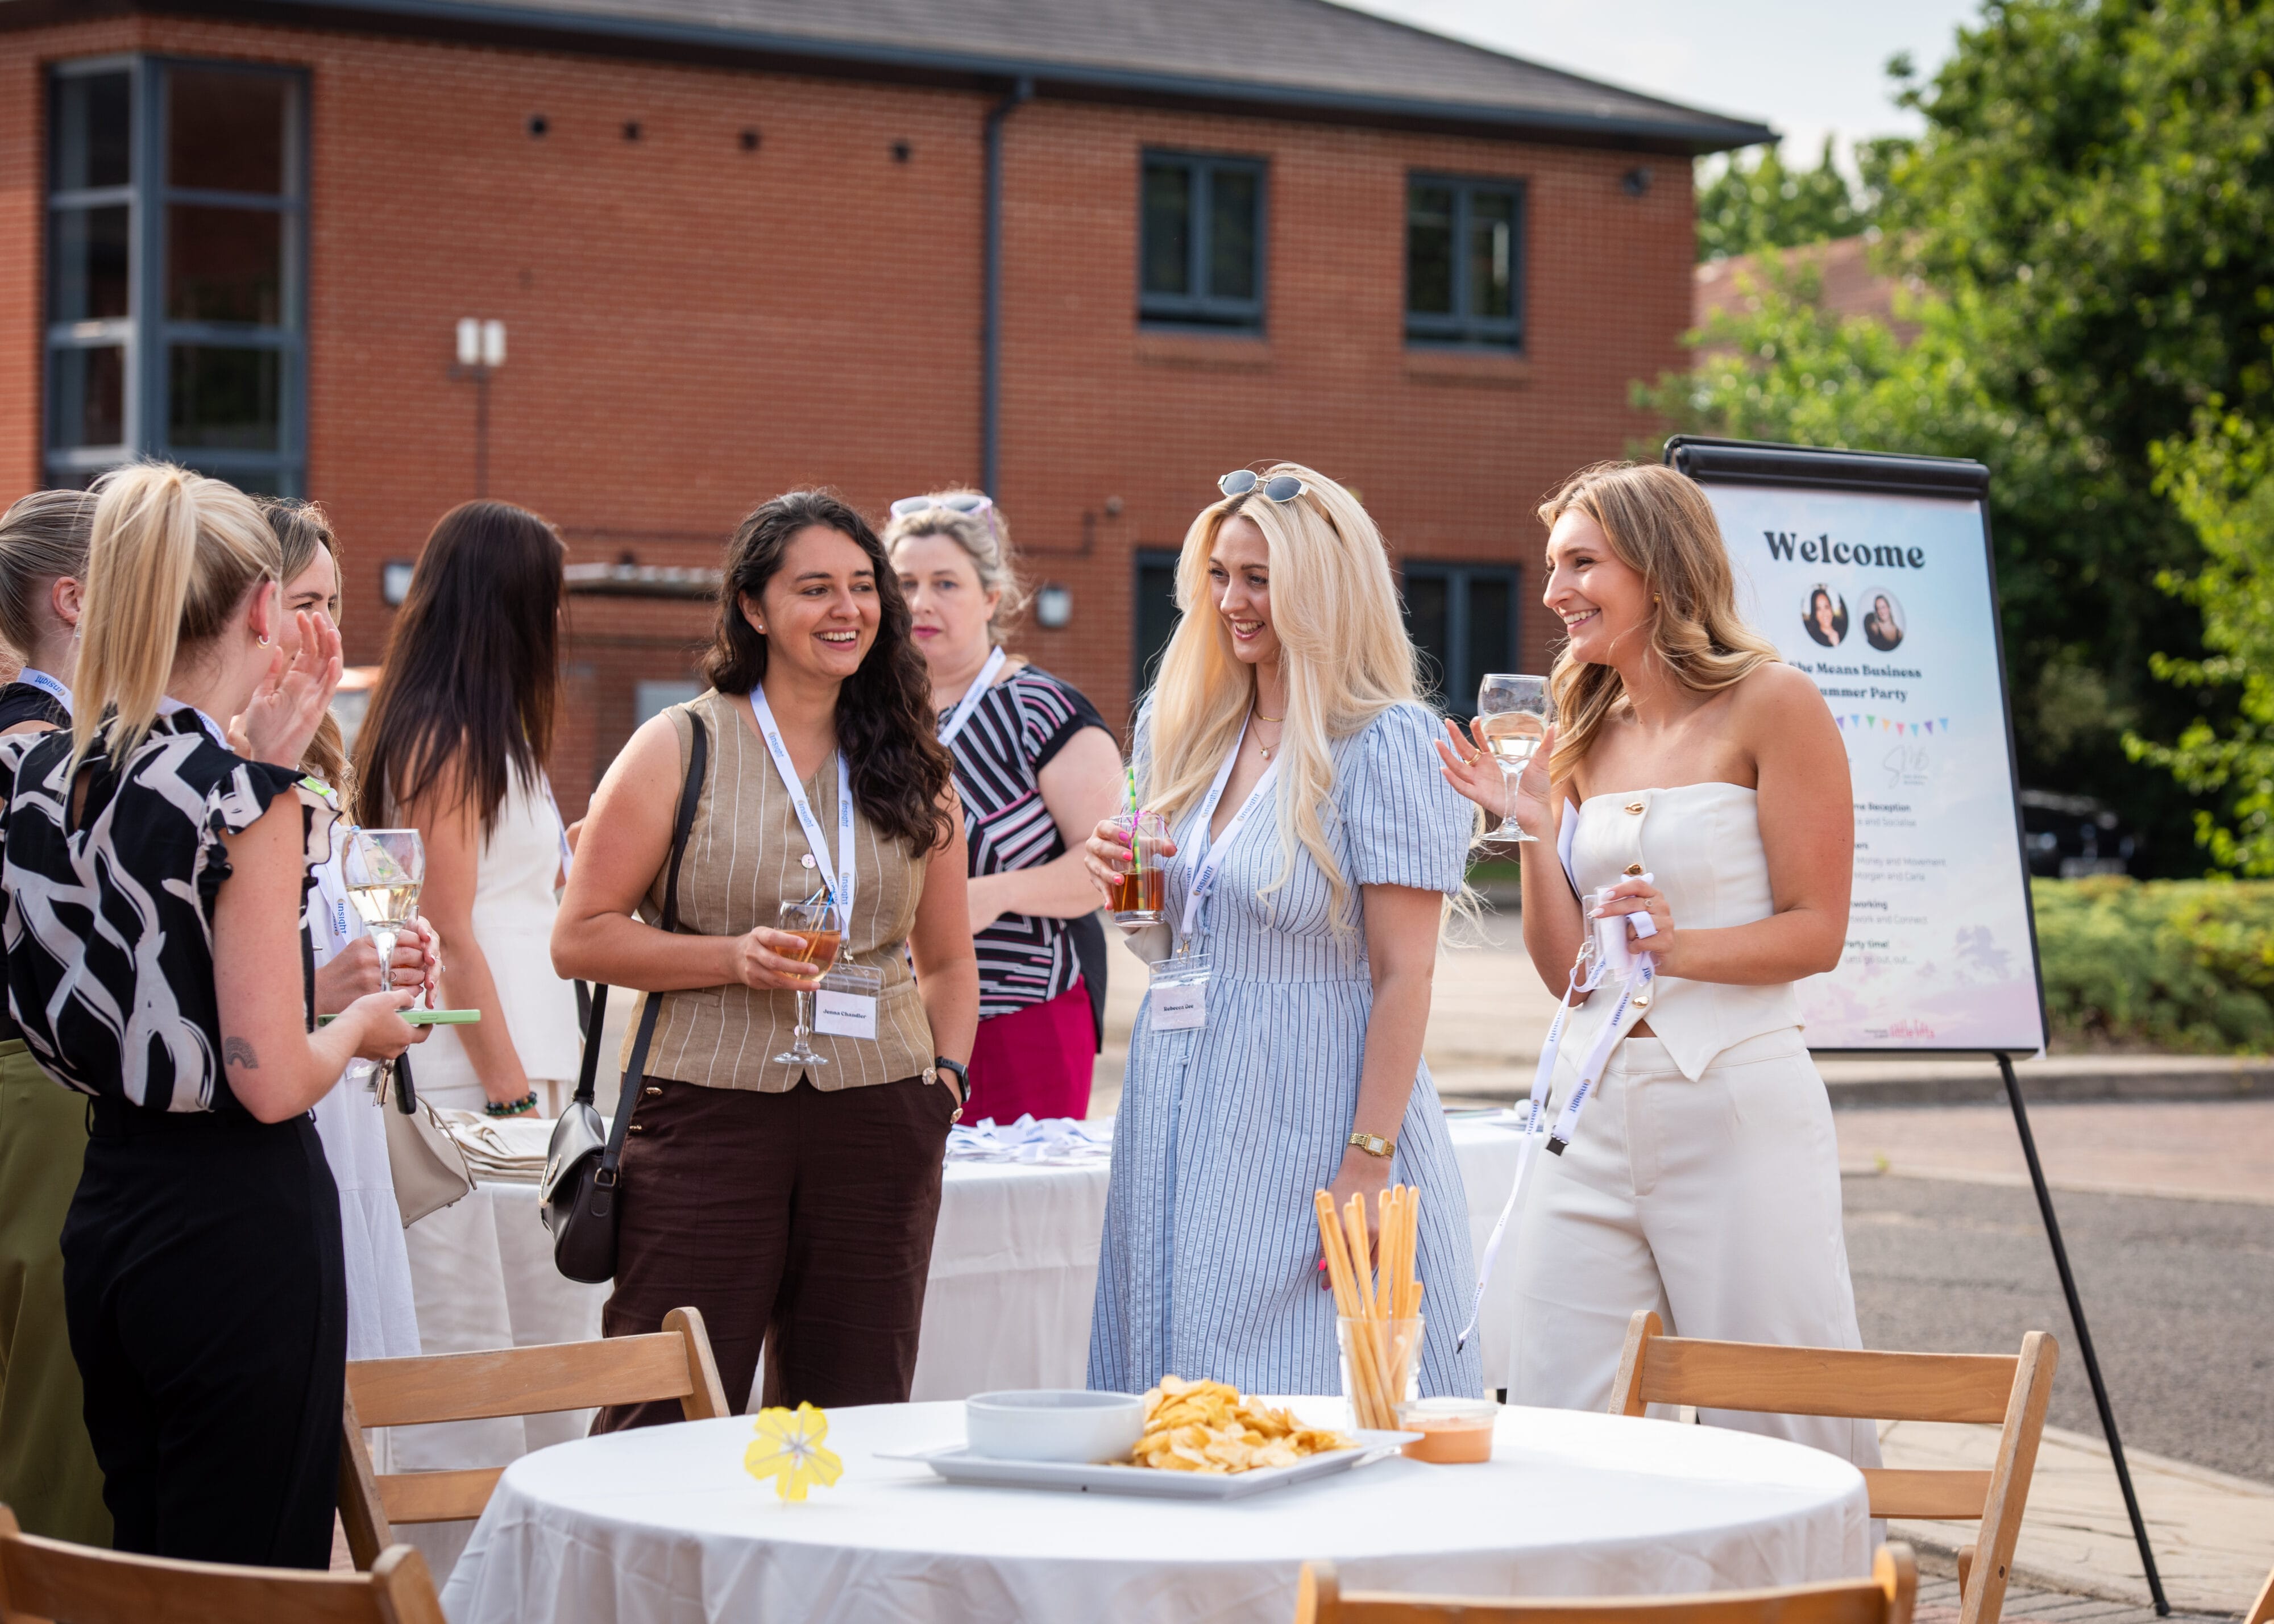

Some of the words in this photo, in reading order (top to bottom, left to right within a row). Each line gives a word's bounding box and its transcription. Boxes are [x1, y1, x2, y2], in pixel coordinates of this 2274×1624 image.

[1764, 531, 1926, 569] Welcome
[1816, 662, 1860, 675] Means
[1862, 663, 1922, 679] Business
[35, 675, 63, 693] insight
[1820, 687, 1867, 698] ummer
[1870, 686, 1908, 703] Party
[769, 734, 785, 758] insight
[798, 802, 814, 828] insight
[1204, 789, 1218, 815] insight
[1240, 793, 1260, 819] insight
[1196, 865, 1214, 893] insight
[337, 903, 347, 934] insight
[841, 1011, 867, 1019] Chandler
[1569, 1082, 1590, 1114] insight
